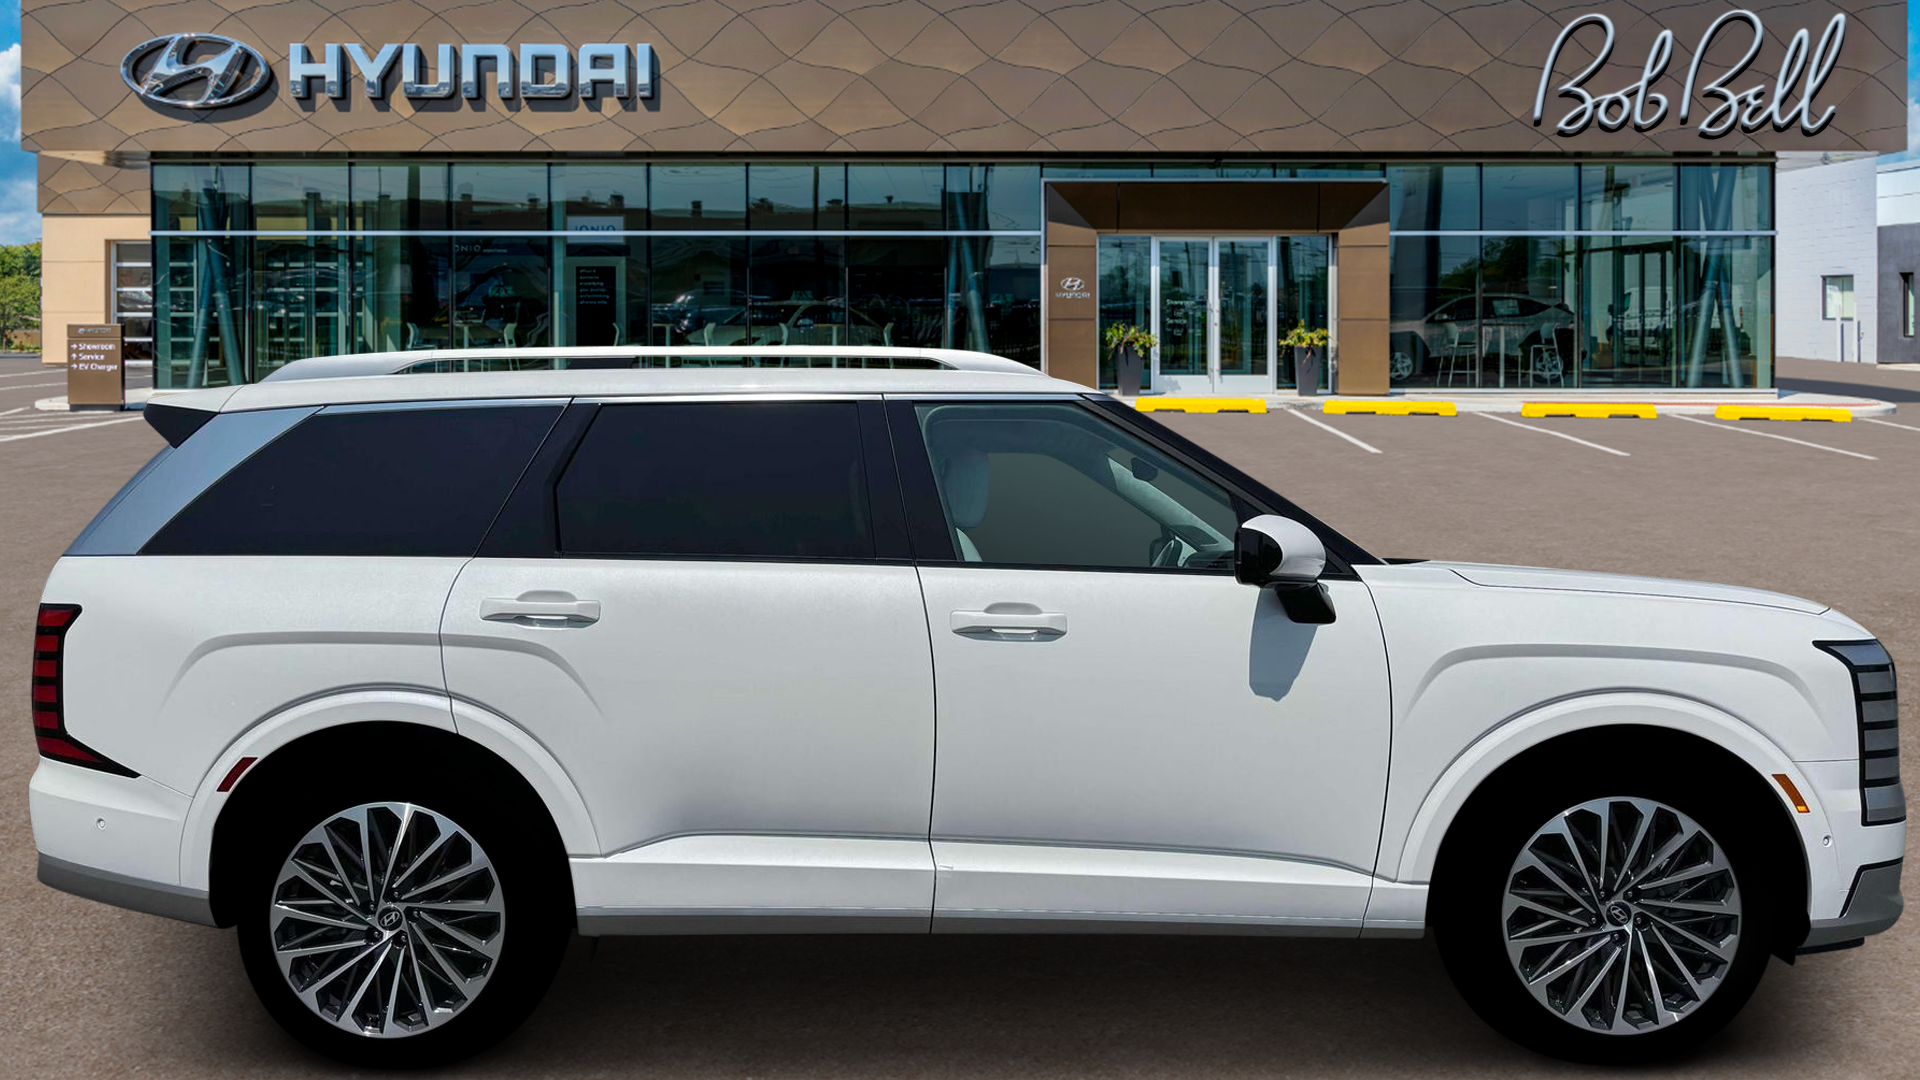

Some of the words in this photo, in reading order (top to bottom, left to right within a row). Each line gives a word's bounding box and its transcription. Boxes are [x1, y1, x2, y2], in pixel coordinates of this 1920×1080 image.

[289, 42, 656, 99] HYUNDAI
[1533, 12, 1674, 135] Bob
[1680, 9, 1847, 136] Bell
[78, 352, 105, 360] Service
[90, 363, 118, 372] Charger
